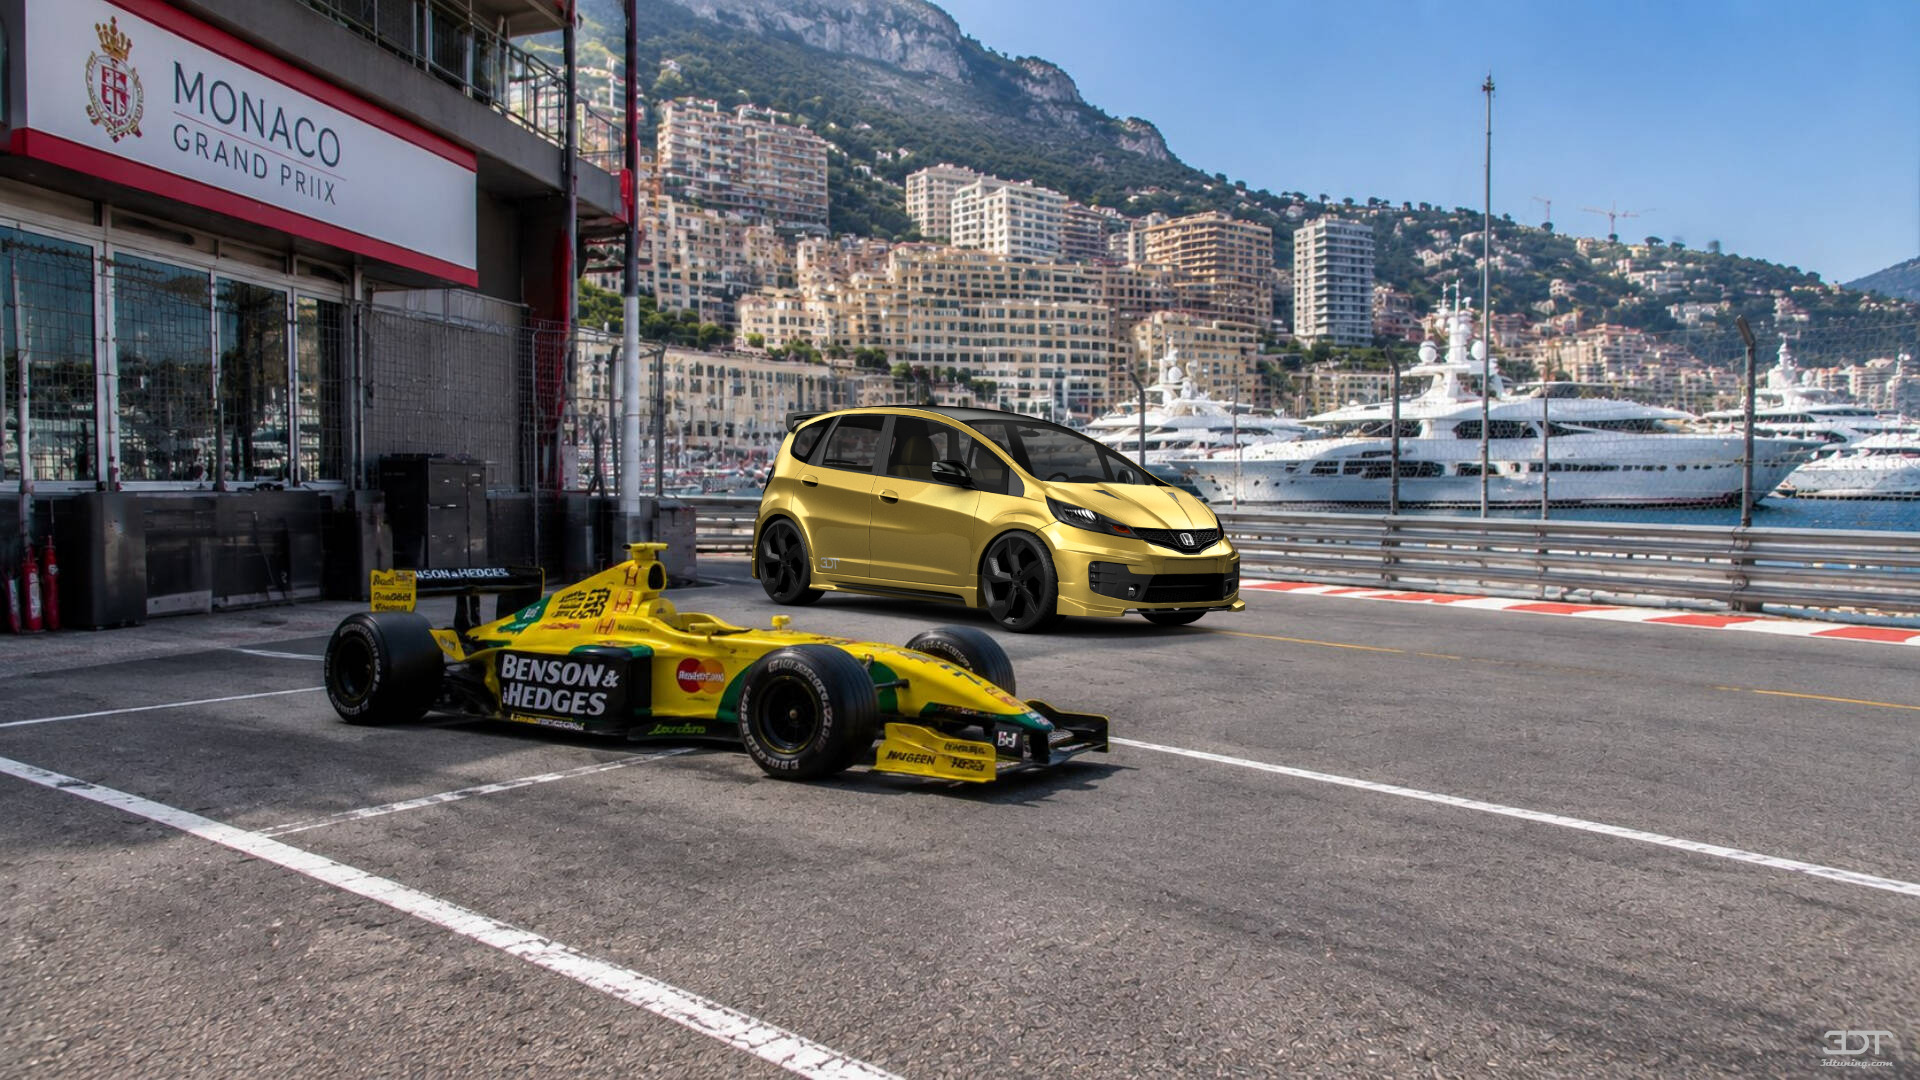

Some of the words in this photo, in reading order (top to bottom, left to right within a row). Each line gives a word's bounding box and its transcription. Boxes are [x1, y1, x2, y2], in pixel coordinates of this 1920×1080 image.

[173, 61, 341, 168] MONACO
[173, 124, 268, 179] GRAND
[415, 569, 450, 579] NSON
